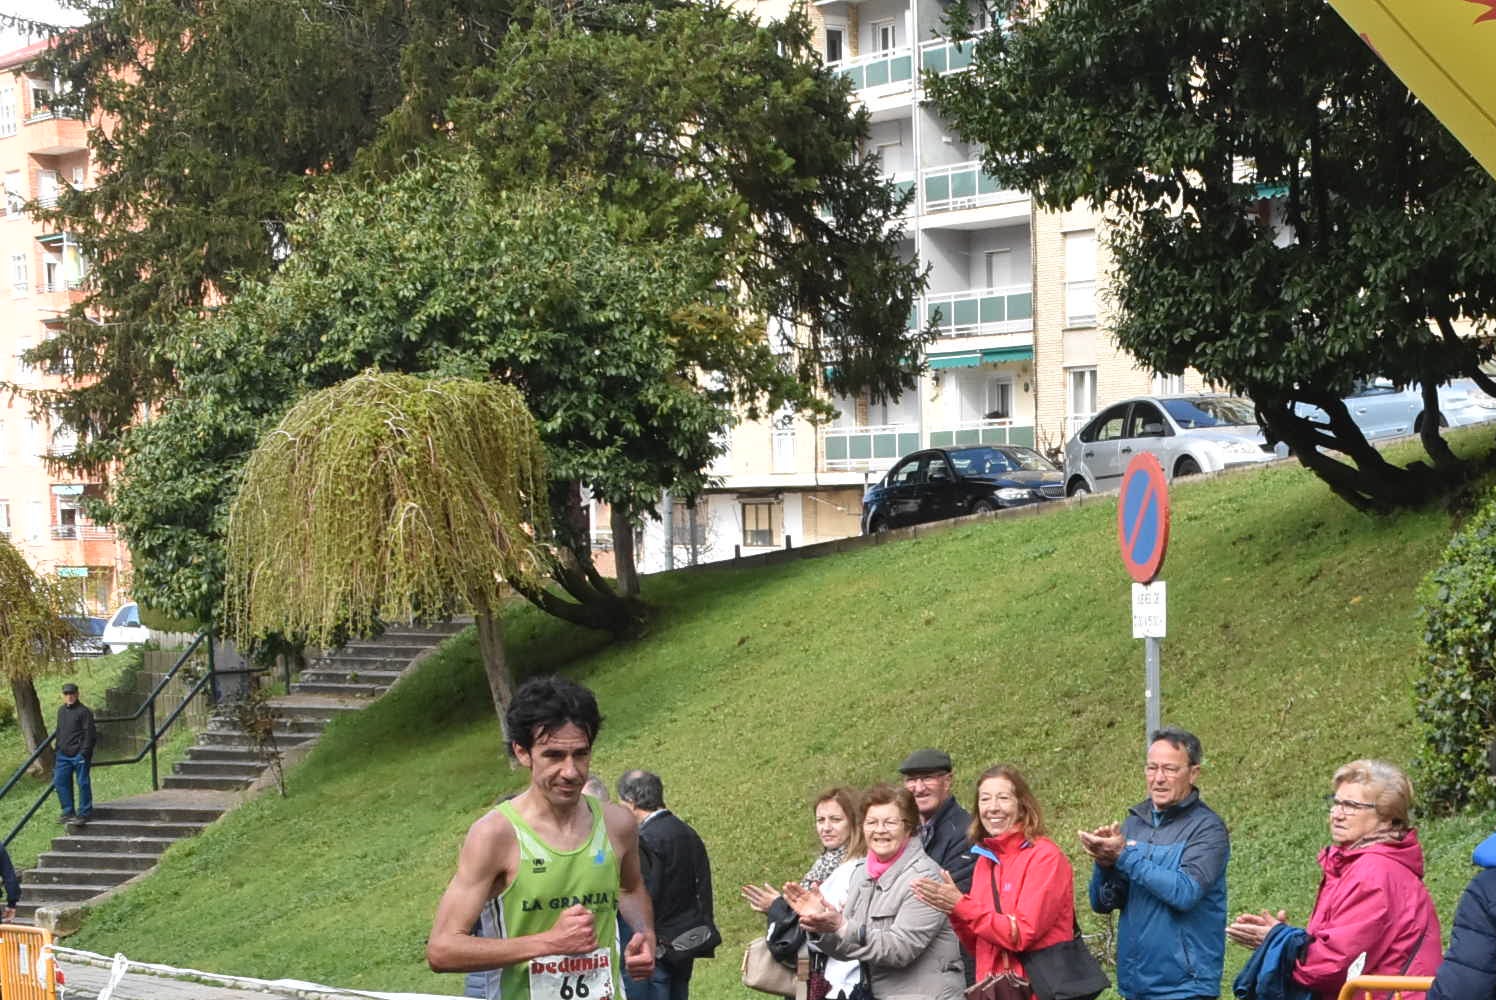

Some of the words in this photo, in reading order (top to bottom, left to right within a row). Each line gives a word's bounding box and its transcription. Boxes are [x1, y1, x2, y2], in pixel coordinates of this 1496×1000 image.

[521, 900, 543, 912] LA
[549, 892, 609, 910] GRANJA
[560, 974, 589, 1000] 66
